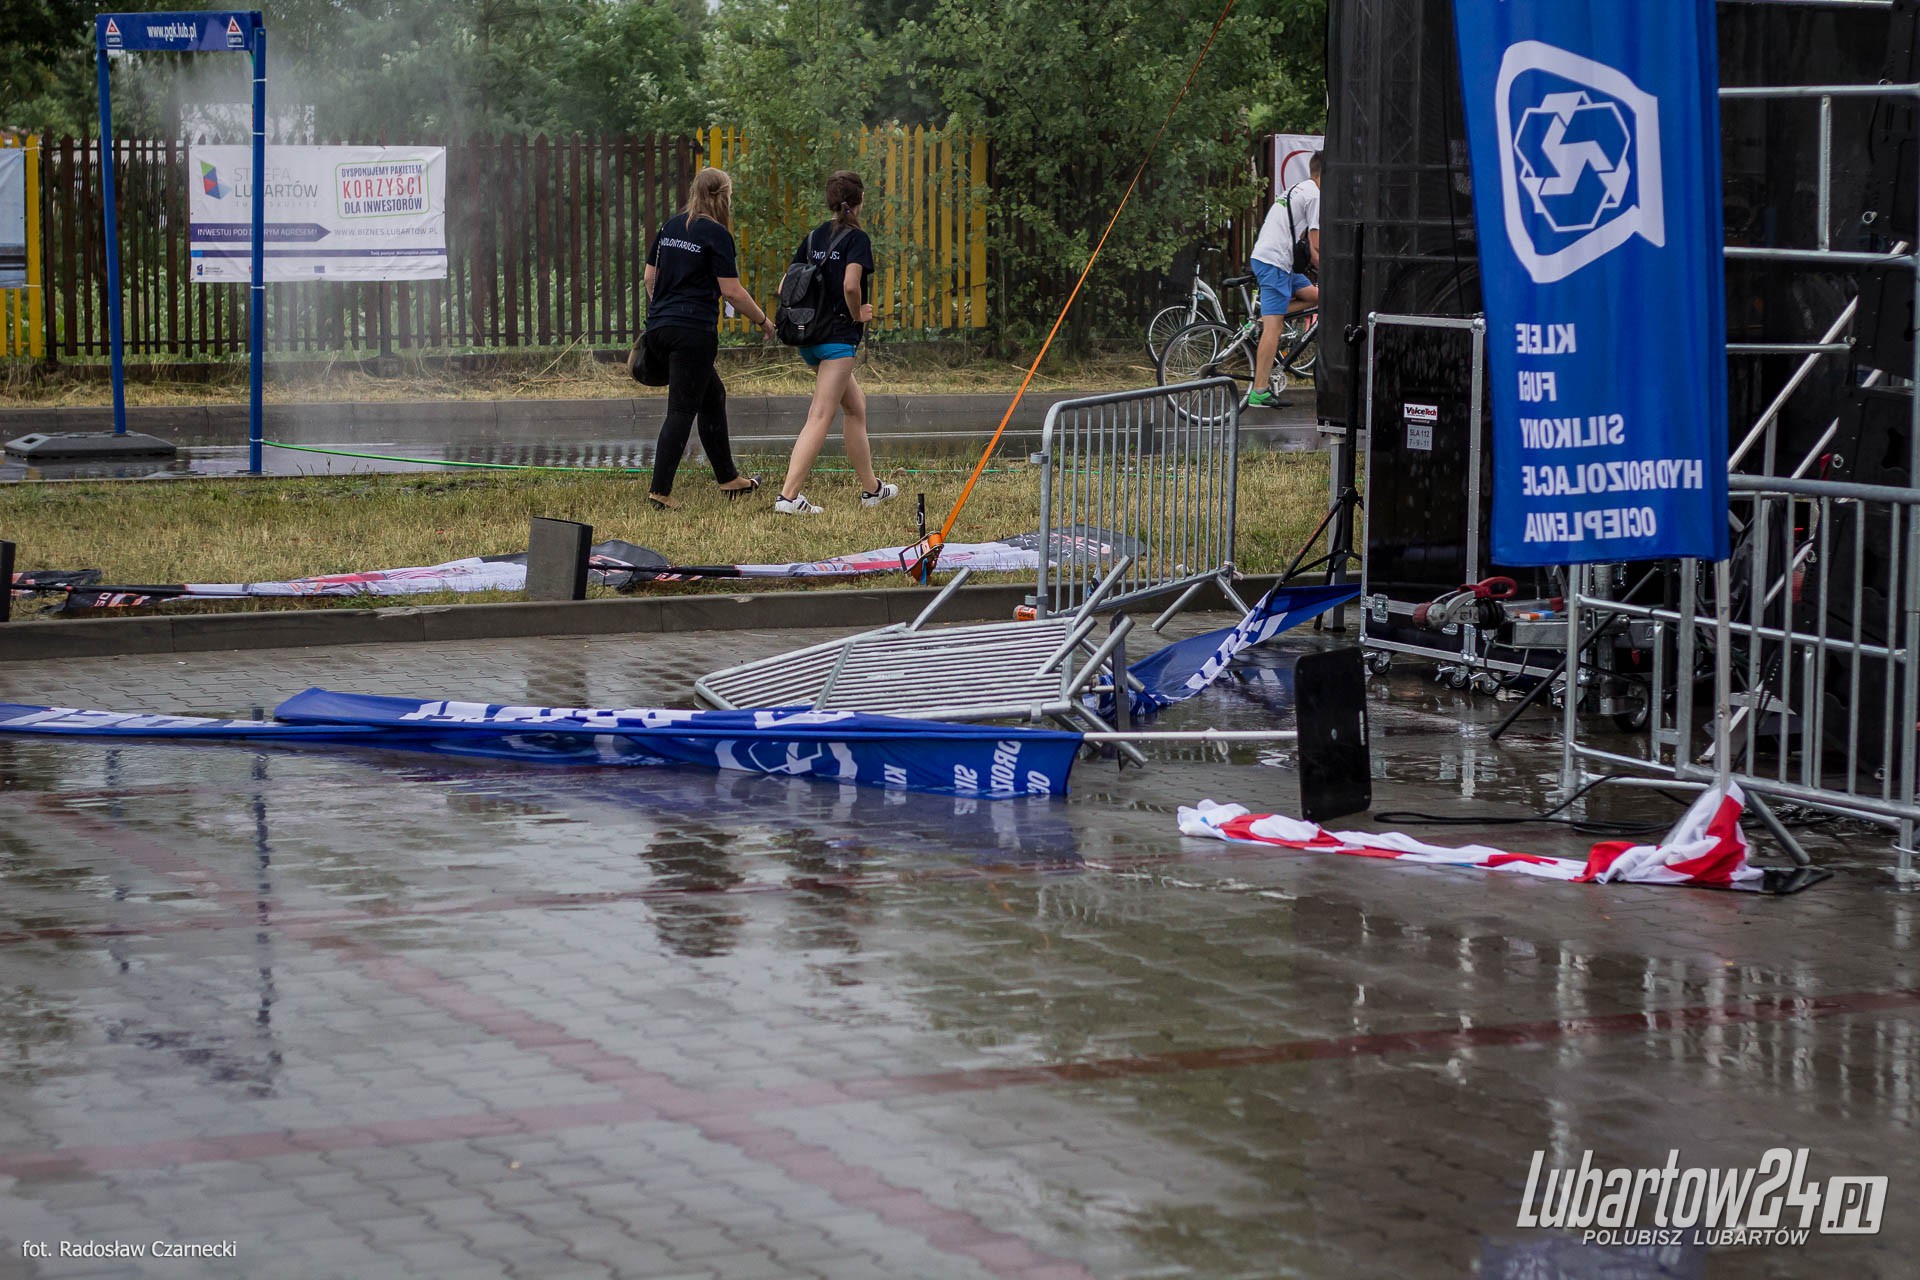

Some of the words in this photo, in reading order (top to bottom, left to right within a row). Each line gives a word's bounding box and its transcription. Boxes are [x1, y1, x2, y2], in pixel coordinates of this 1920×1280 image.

[147, 22, 197, 41] www.pgk.lub.pl
[234, 167, 291, 182] STEFA
[341, 166, 389, 178] DYSPONUJEMY
[390, 164, 423, 175] PAKIETEM
[235, 180, 318, 198] LUARTÓW
[343, 174, 422, 199] KORZYŚCI
[344, 201, 361, 214] DLA
[363, 196, 422, 213] INWESTORÓW
[197, 228, 231, 236] INWESTUJ
[233, 228, 248, 236] POD
